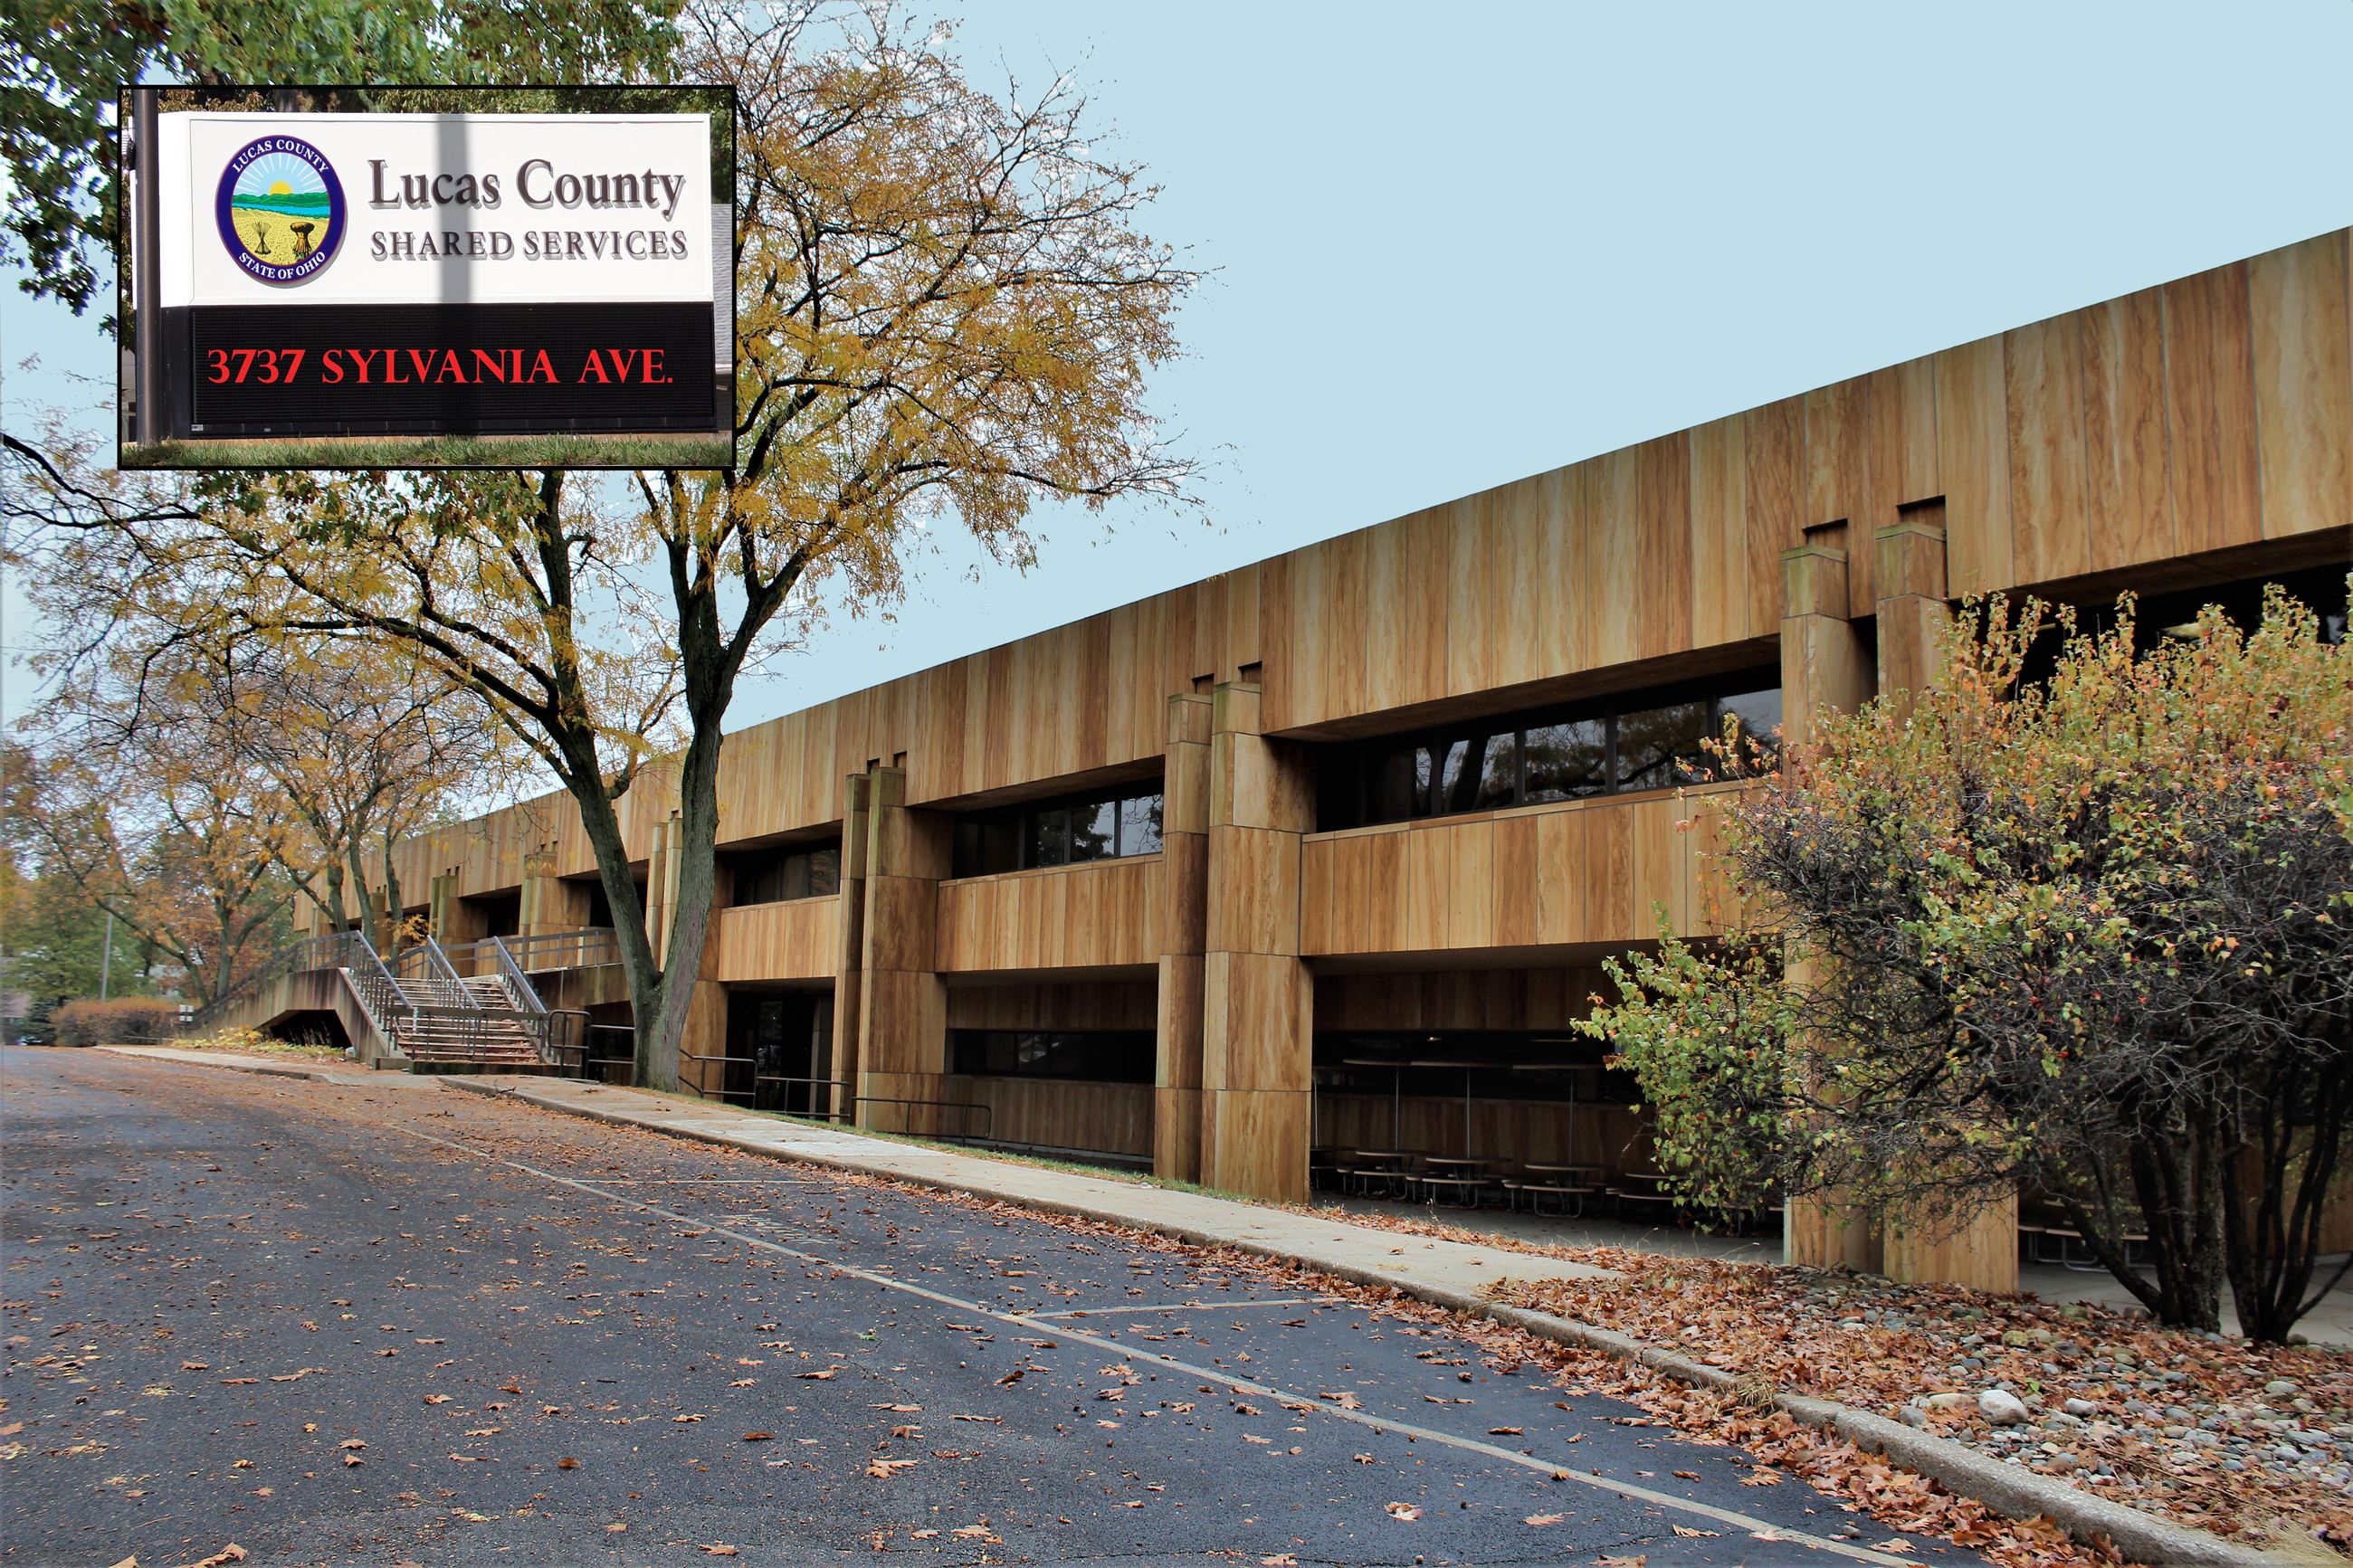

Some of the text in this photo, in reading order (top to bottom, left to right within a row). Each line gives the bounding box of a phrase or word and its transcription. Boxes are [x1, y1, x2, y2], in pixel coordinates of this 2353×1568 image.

[232, 139, 329, 175] LUCAS COUNTY
[367, 158, 685, 219] Lucas County
[371, 230, 687, 258] SHARED SERVICES
[239, 251, 326, 280] STATE OF OHIO
[208, 349, 673, 384] 3737 SYLVANIA AVE.
